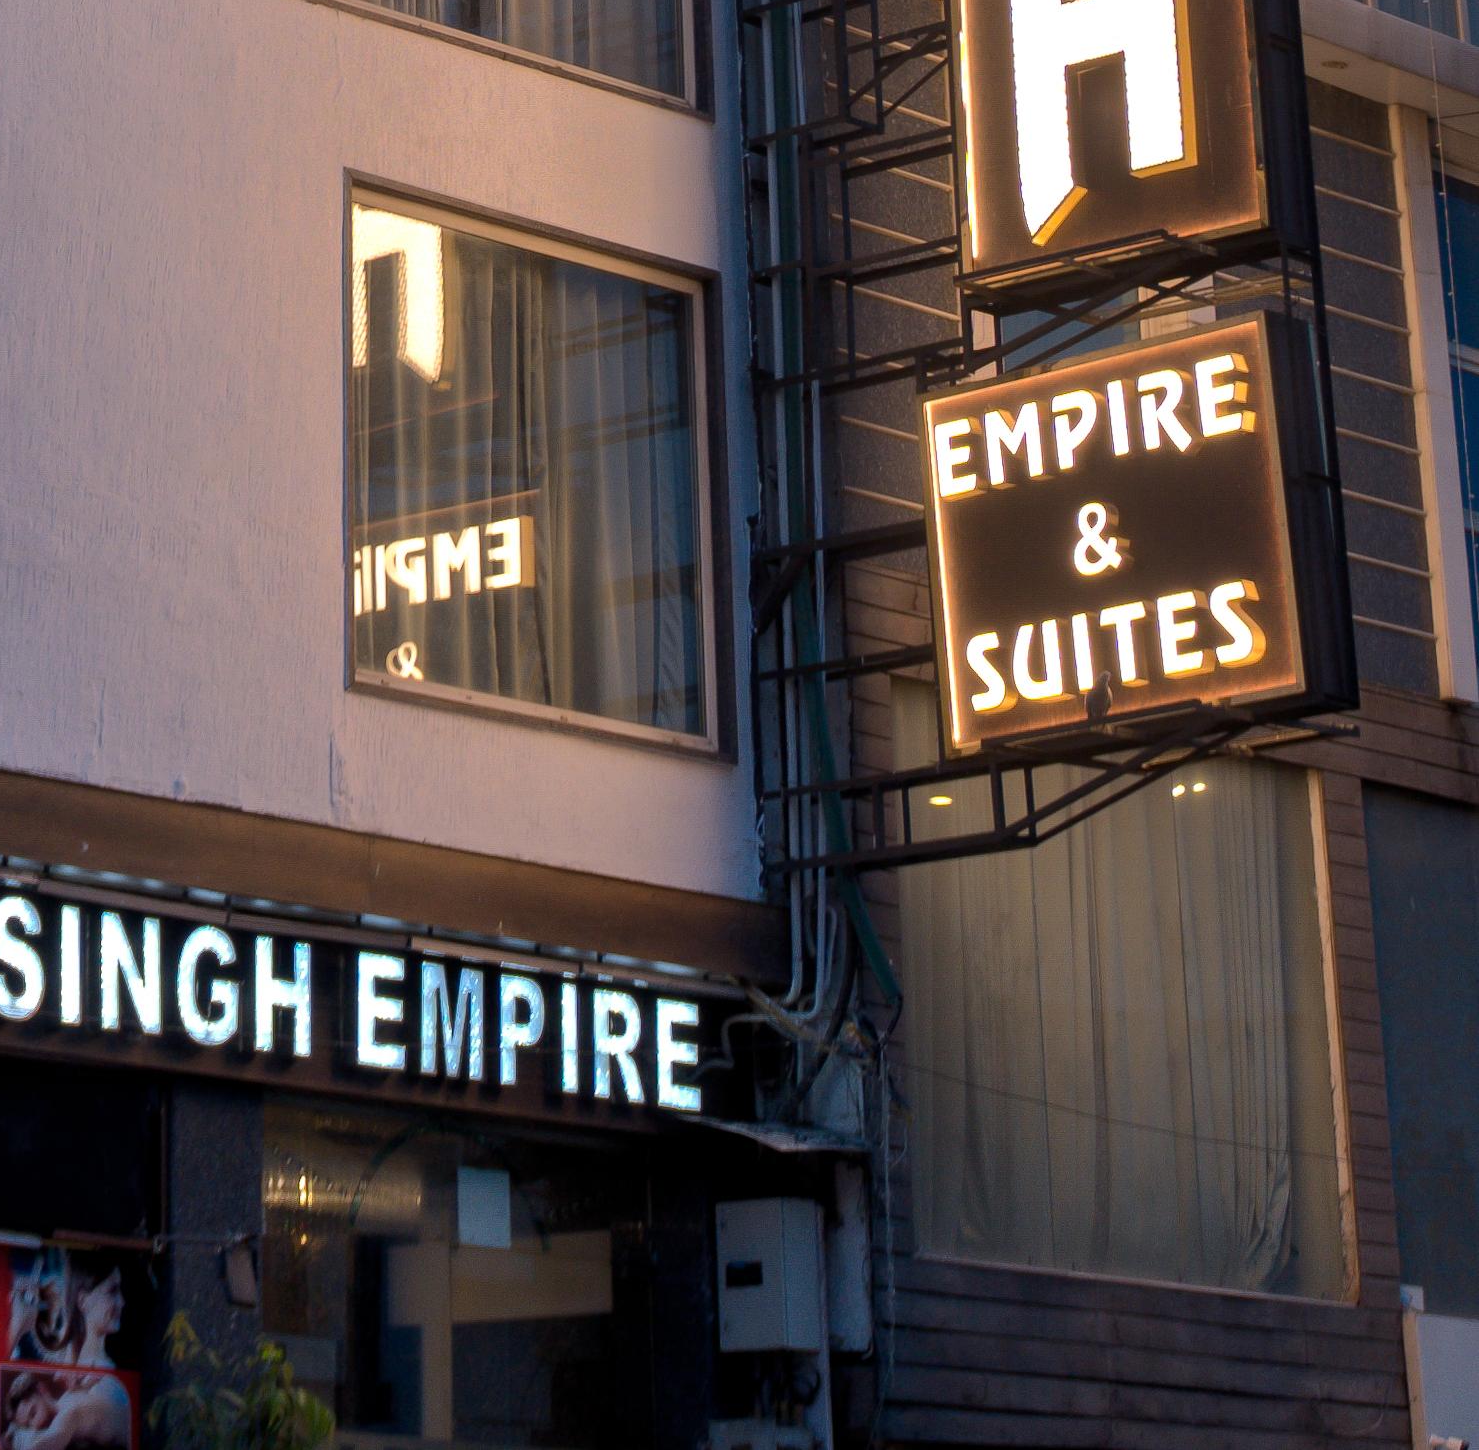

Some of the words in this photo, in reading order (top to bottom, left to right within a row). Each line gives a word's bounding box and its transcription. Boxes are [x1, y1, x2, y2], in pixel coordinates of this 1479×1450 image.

[933, 352, 1256, 499] EMPIRE
[1072, 501, 1130, 577] &
[965, 580, 1266, 713] SUITES
[356, 951, 702, 1112] EMPIRE
